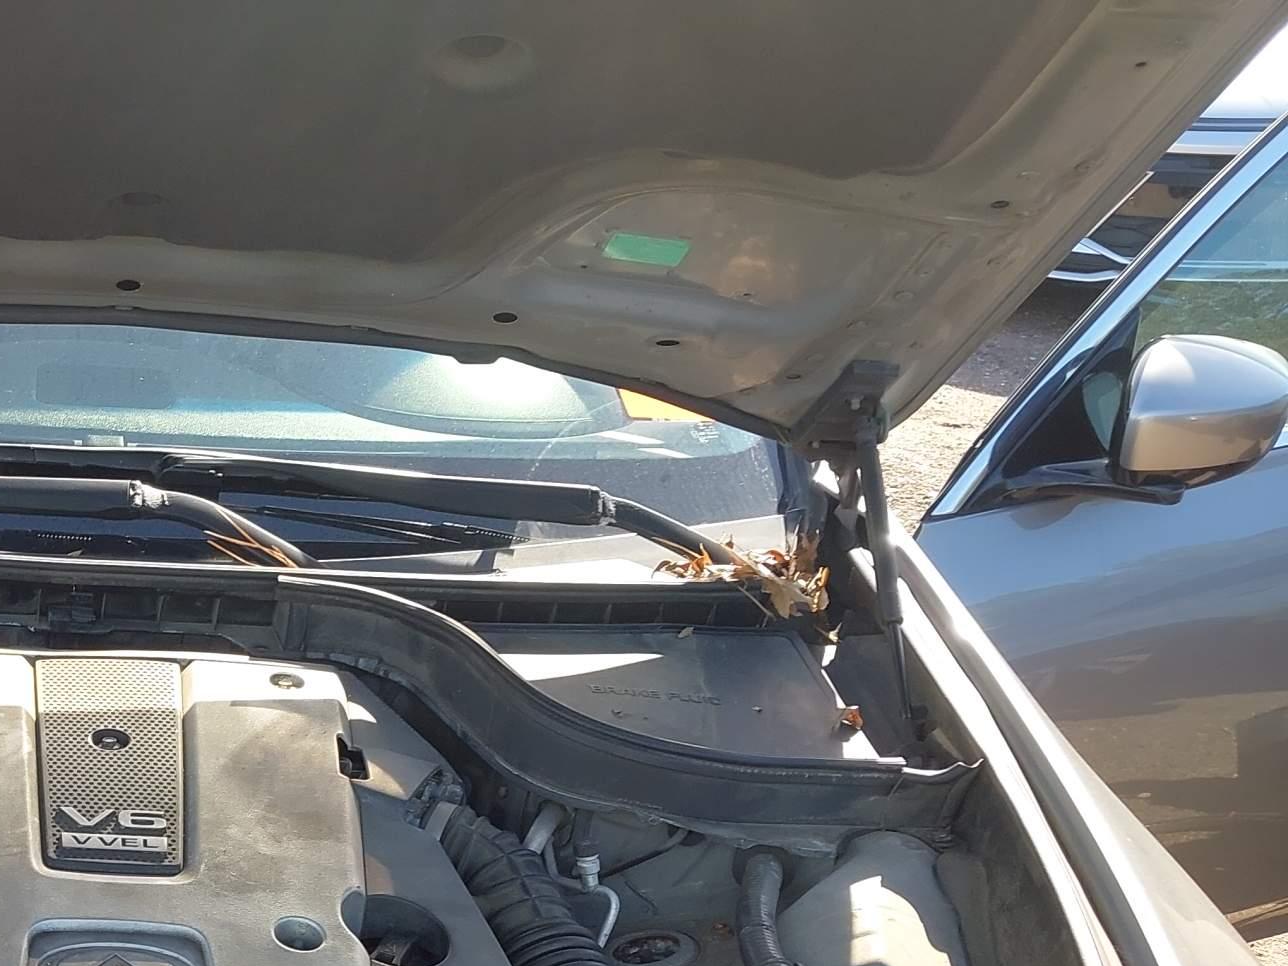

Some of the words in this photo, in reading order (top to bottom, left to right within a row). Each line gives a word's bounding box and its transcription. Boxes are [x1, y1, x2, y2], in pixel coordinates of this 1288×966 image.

[590, 685, 661, 699] BRAKE
[59, 806, 167, 829] V6
[72, 835, 159, 848] VVEL
